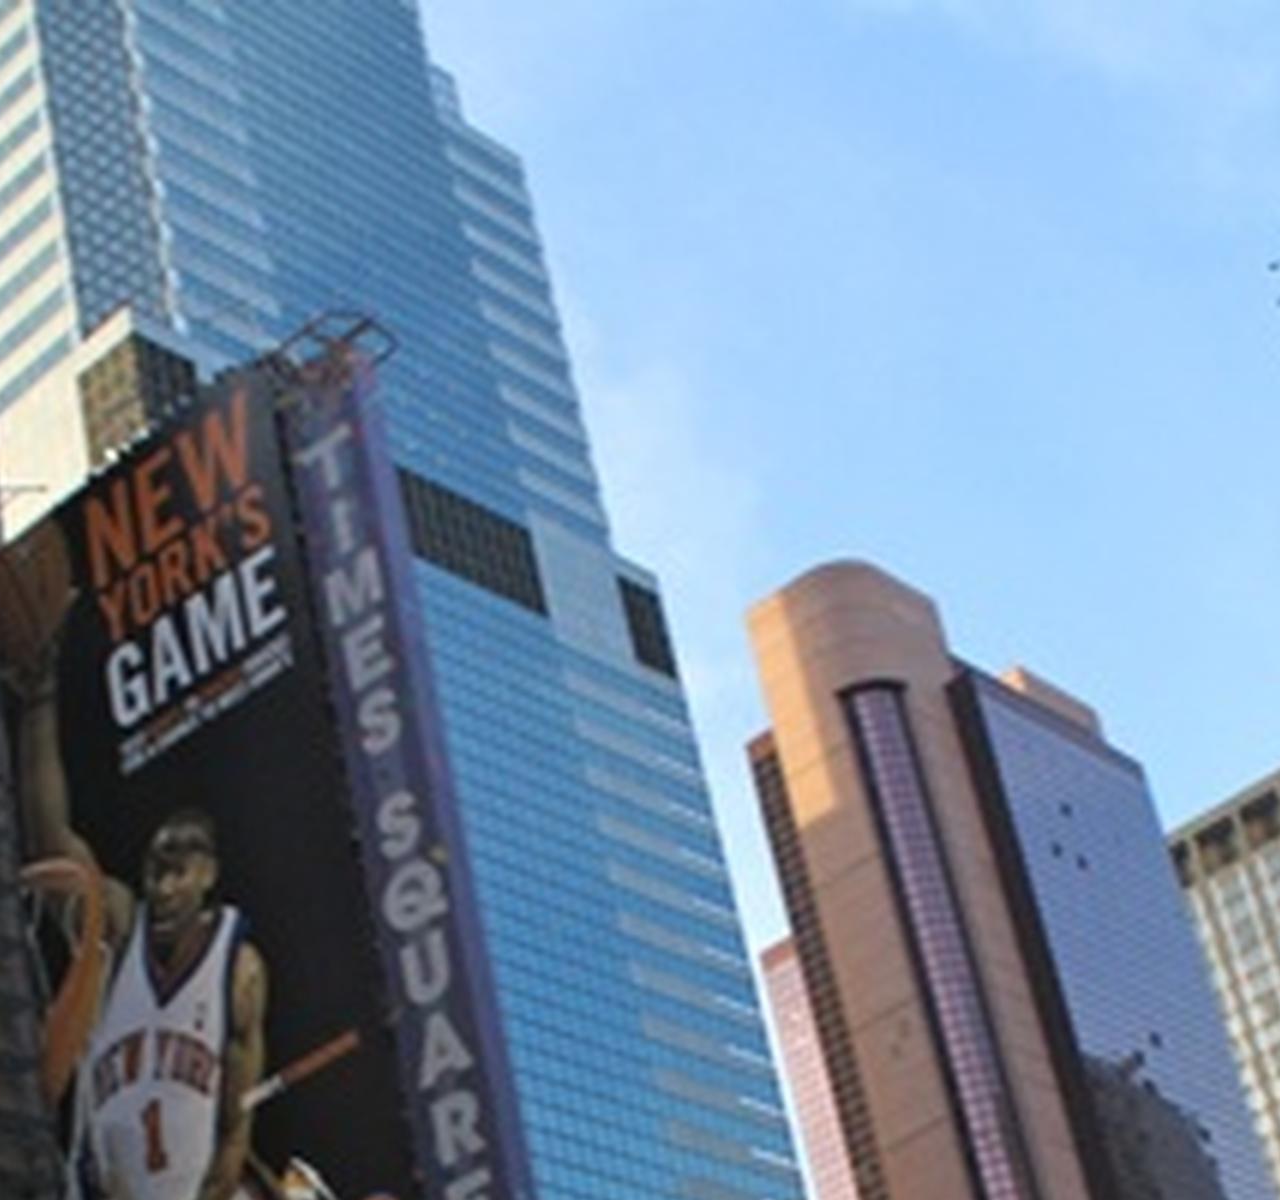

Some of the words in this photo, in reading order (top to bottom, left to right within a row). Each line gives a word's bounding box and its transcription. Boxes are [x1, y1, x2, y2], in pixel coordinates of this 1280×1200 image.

[83, 389, 251, 587] NEW
[97, 485, 272, 640] YORK'S
[106, 546, 287, 728] GAME
[296, 423, 400, 756] TIMES
[140, 1098, 168, 1174] 1
